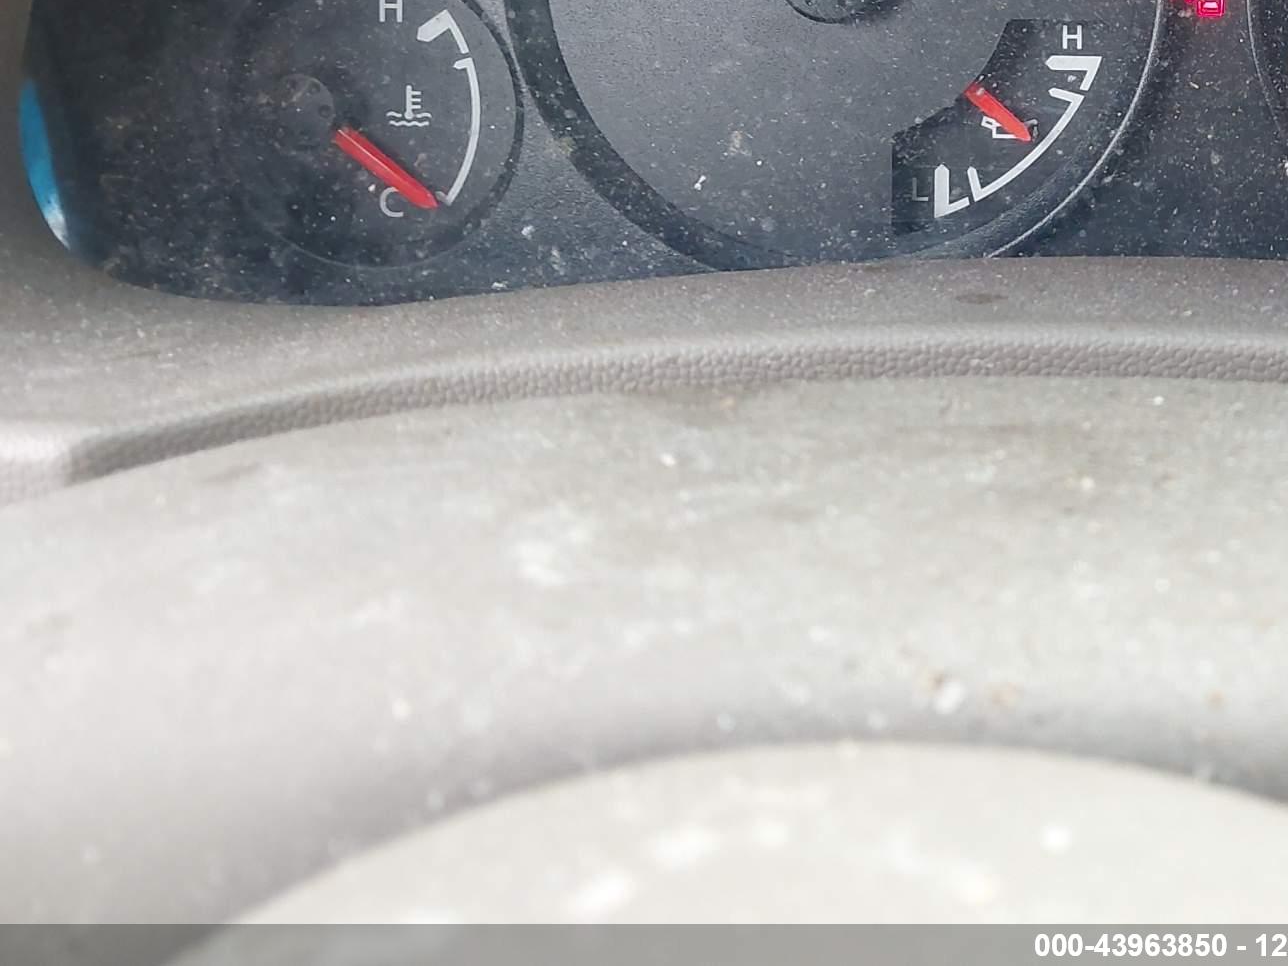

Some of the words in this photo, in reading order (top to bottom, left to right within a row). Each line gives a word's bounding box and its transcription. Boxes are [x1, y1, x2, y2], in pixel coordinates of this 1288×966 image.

[1062, 24, 1083, 50] H
[379, 186, 404, 218] C
[912, 177, 929, 202] L
